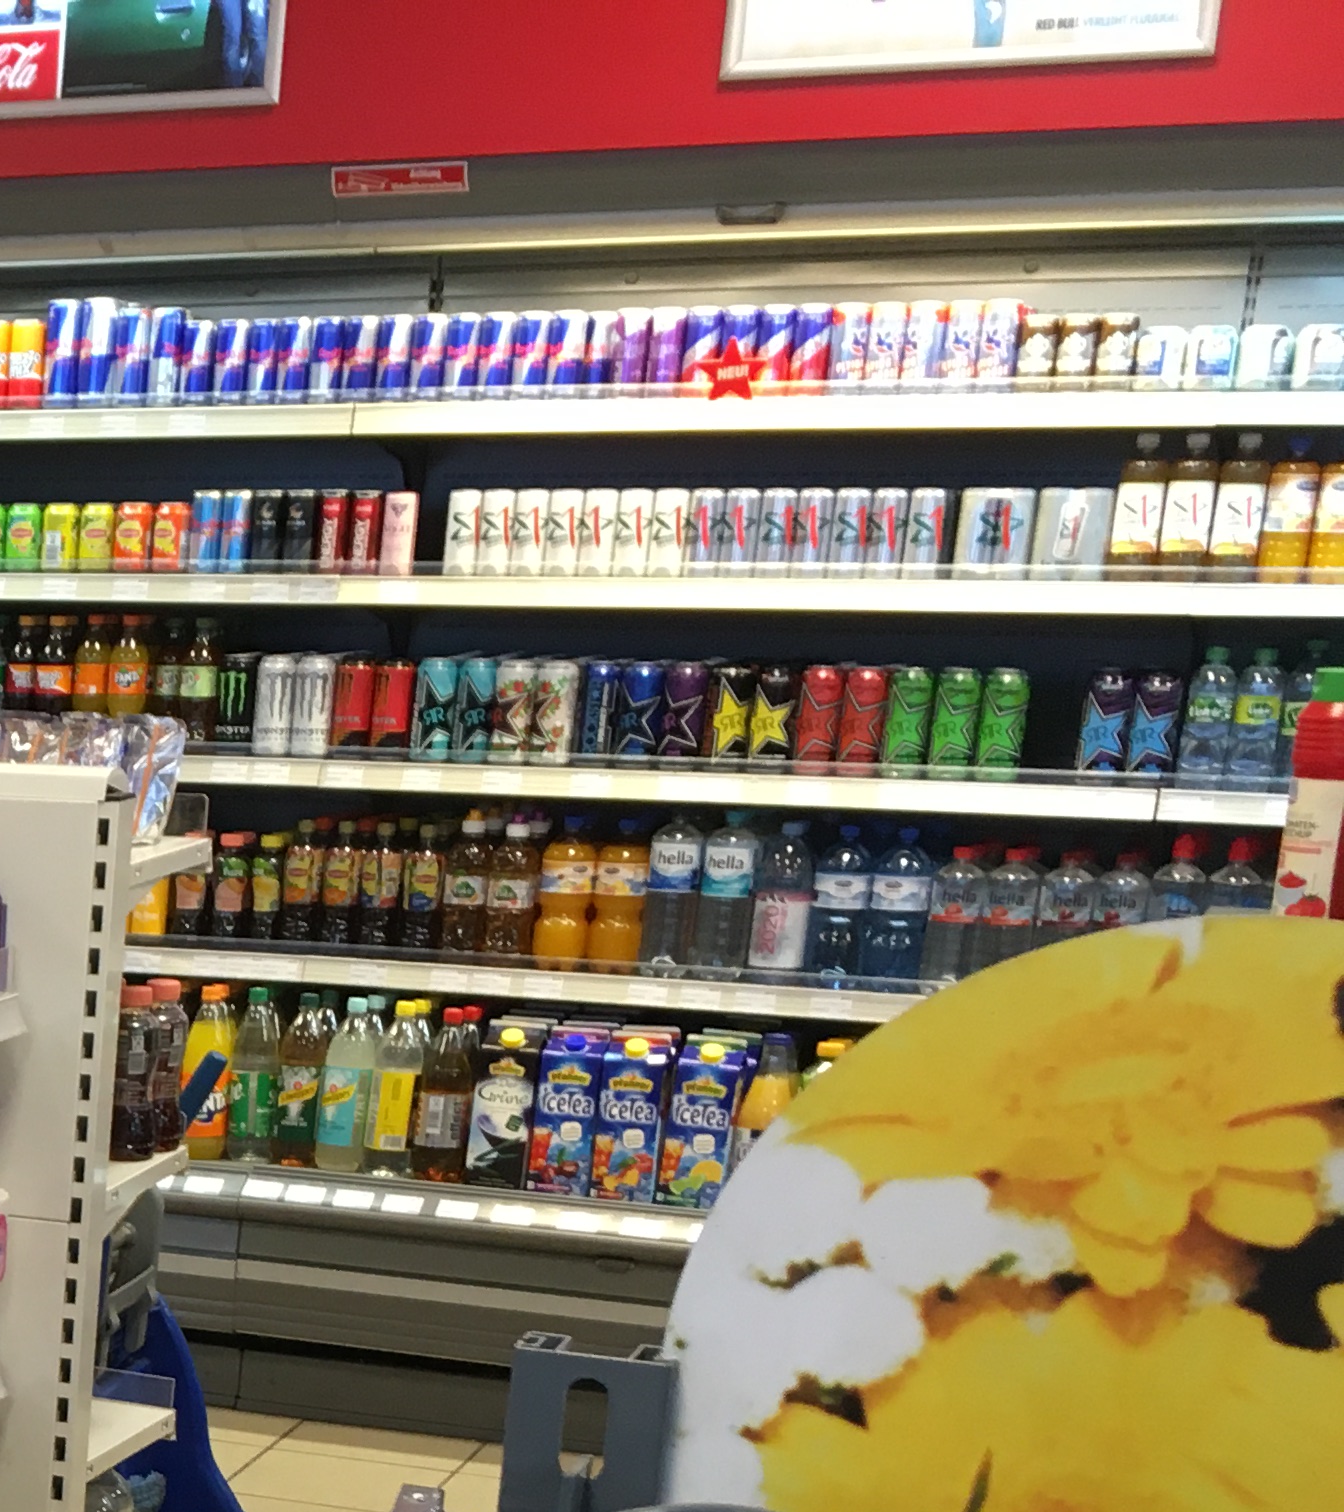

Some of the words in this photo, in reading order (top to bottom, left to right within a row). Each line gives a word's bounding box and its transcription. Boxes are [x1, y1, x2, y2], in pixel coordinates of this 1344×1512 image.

[1036, 19, 1055, 31] RED
[716, 363, 750, 381] NEU!
[657, 848, 695, 867] hella
[707, 853, 745, 872] hella
